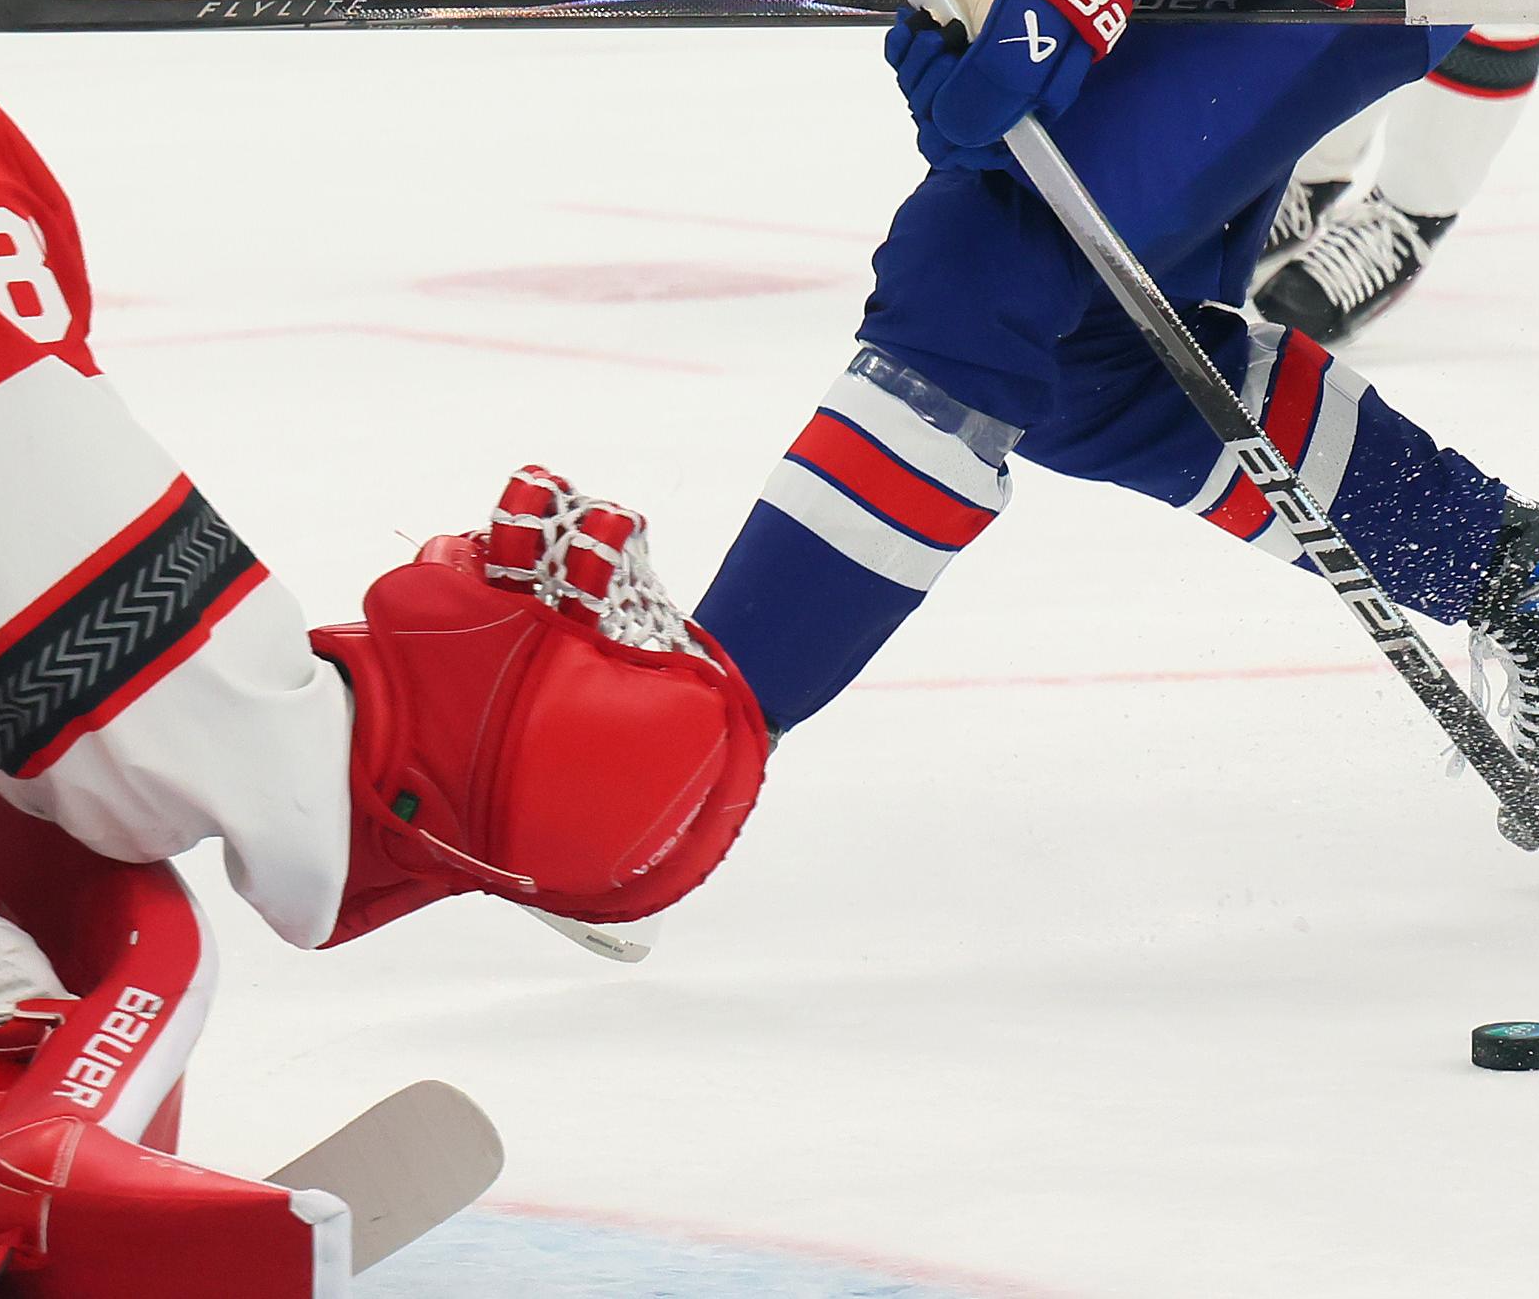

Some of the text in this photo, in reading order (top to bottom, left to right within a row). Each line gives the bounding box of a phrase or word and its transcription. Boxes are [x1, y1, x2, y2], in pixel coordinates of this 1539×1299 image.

[196, 0, 367, 19] FLYLITE
[1224, 437, 1443, 680] BAUER
[52, 986, 165, 1110] BAUER
